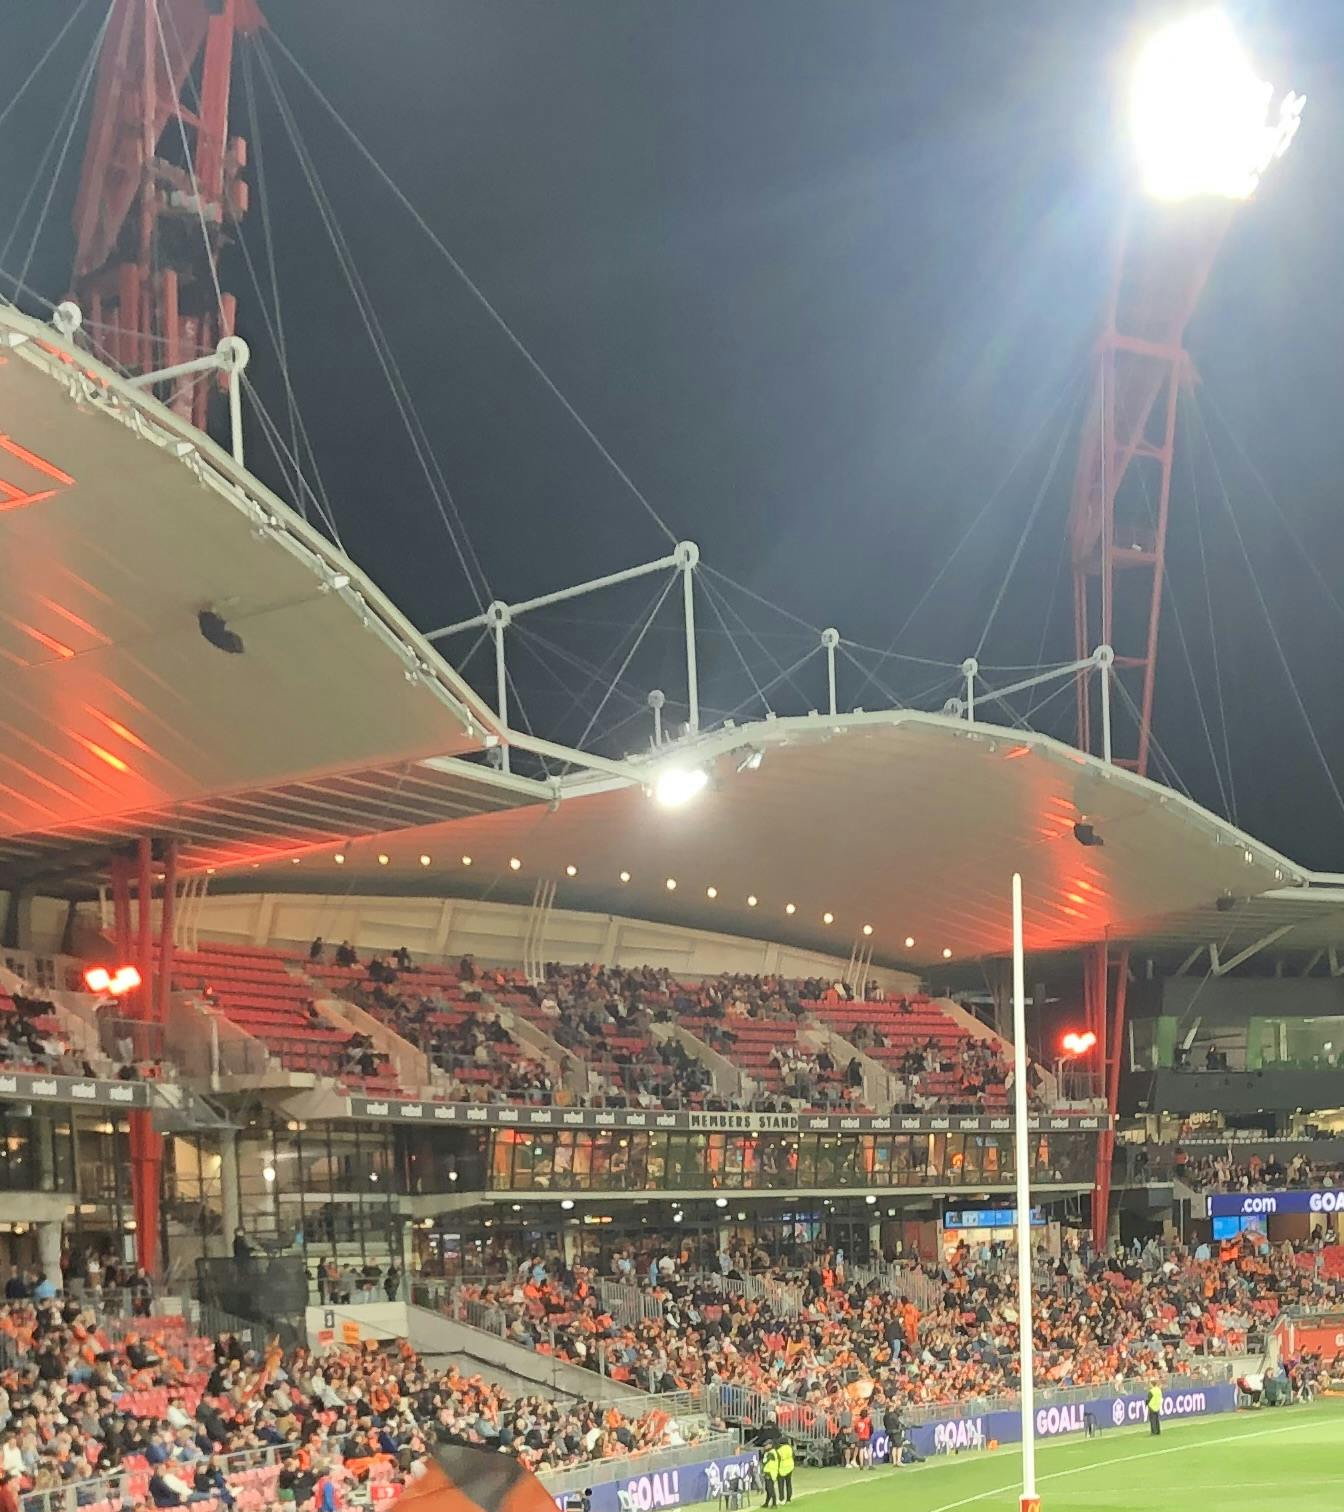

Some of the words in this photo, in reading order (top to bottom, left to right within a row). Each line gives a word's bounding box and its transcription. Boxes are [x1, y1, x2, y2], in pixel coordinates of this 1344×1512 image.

[691, 1114, 751, 1129] MEMBERS
[759, 1116, 798, 1129] STAND
[1037, 1404, 1085, 1435] GOAL!
[628, 1470, 680, 1511] GOAL!
